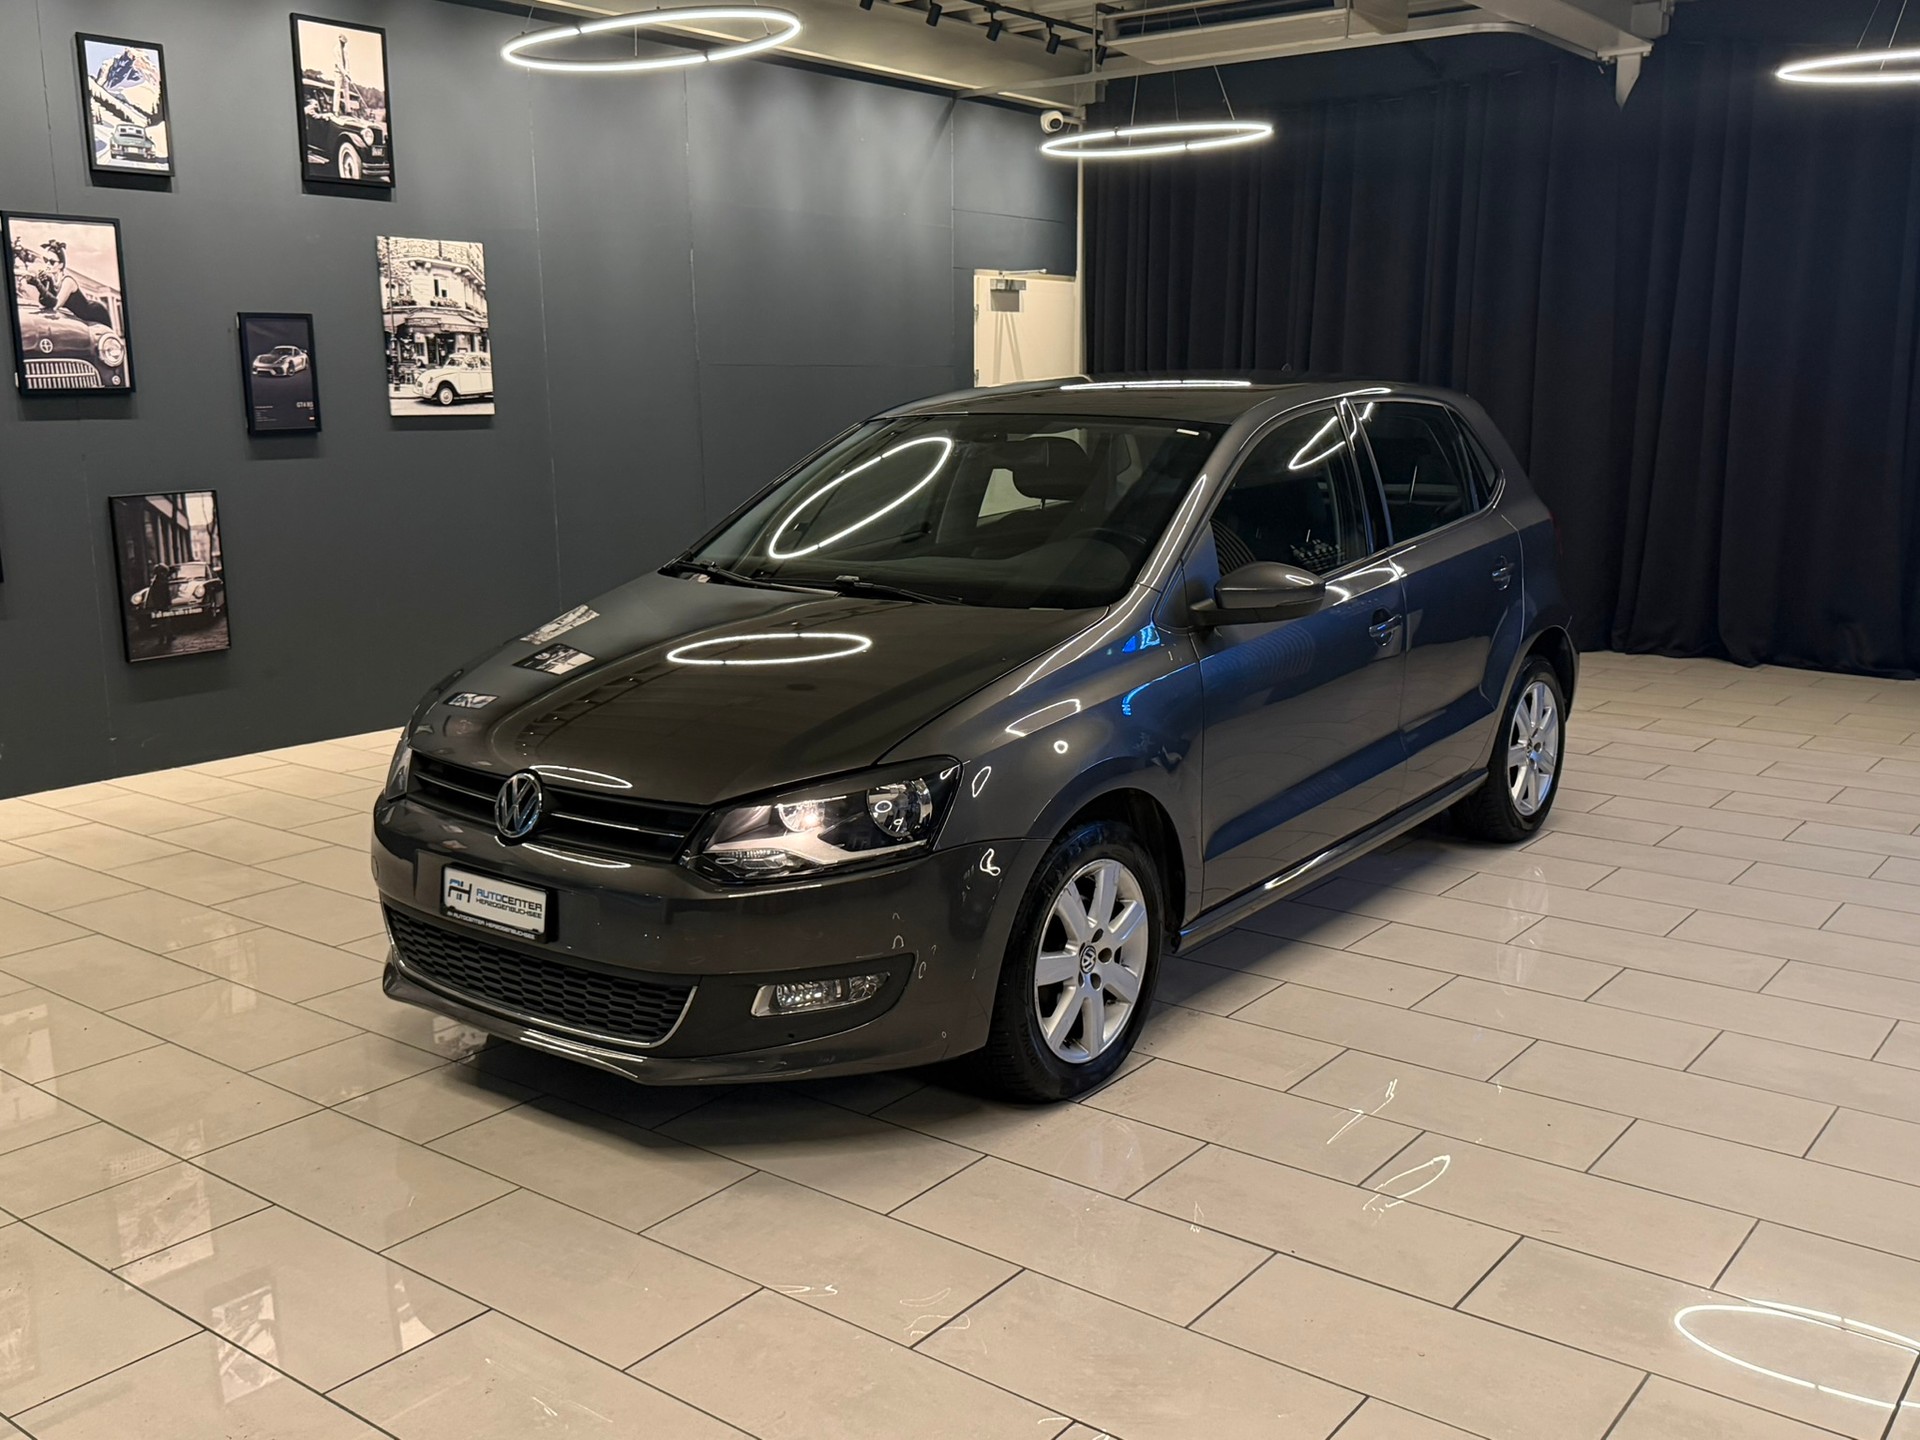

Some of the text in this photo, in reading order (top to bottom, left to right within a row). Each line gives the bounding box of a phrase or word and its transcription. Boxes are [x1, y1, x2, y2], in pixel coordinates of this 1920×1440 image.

[497, 773, 541, 838] VW
[476, 888, 543, 912] AUTOCENTER
[476, 897, 543, 919] HERZOGENBUCHSEE
[453, 912, 485, 926] AUTOCENTER
